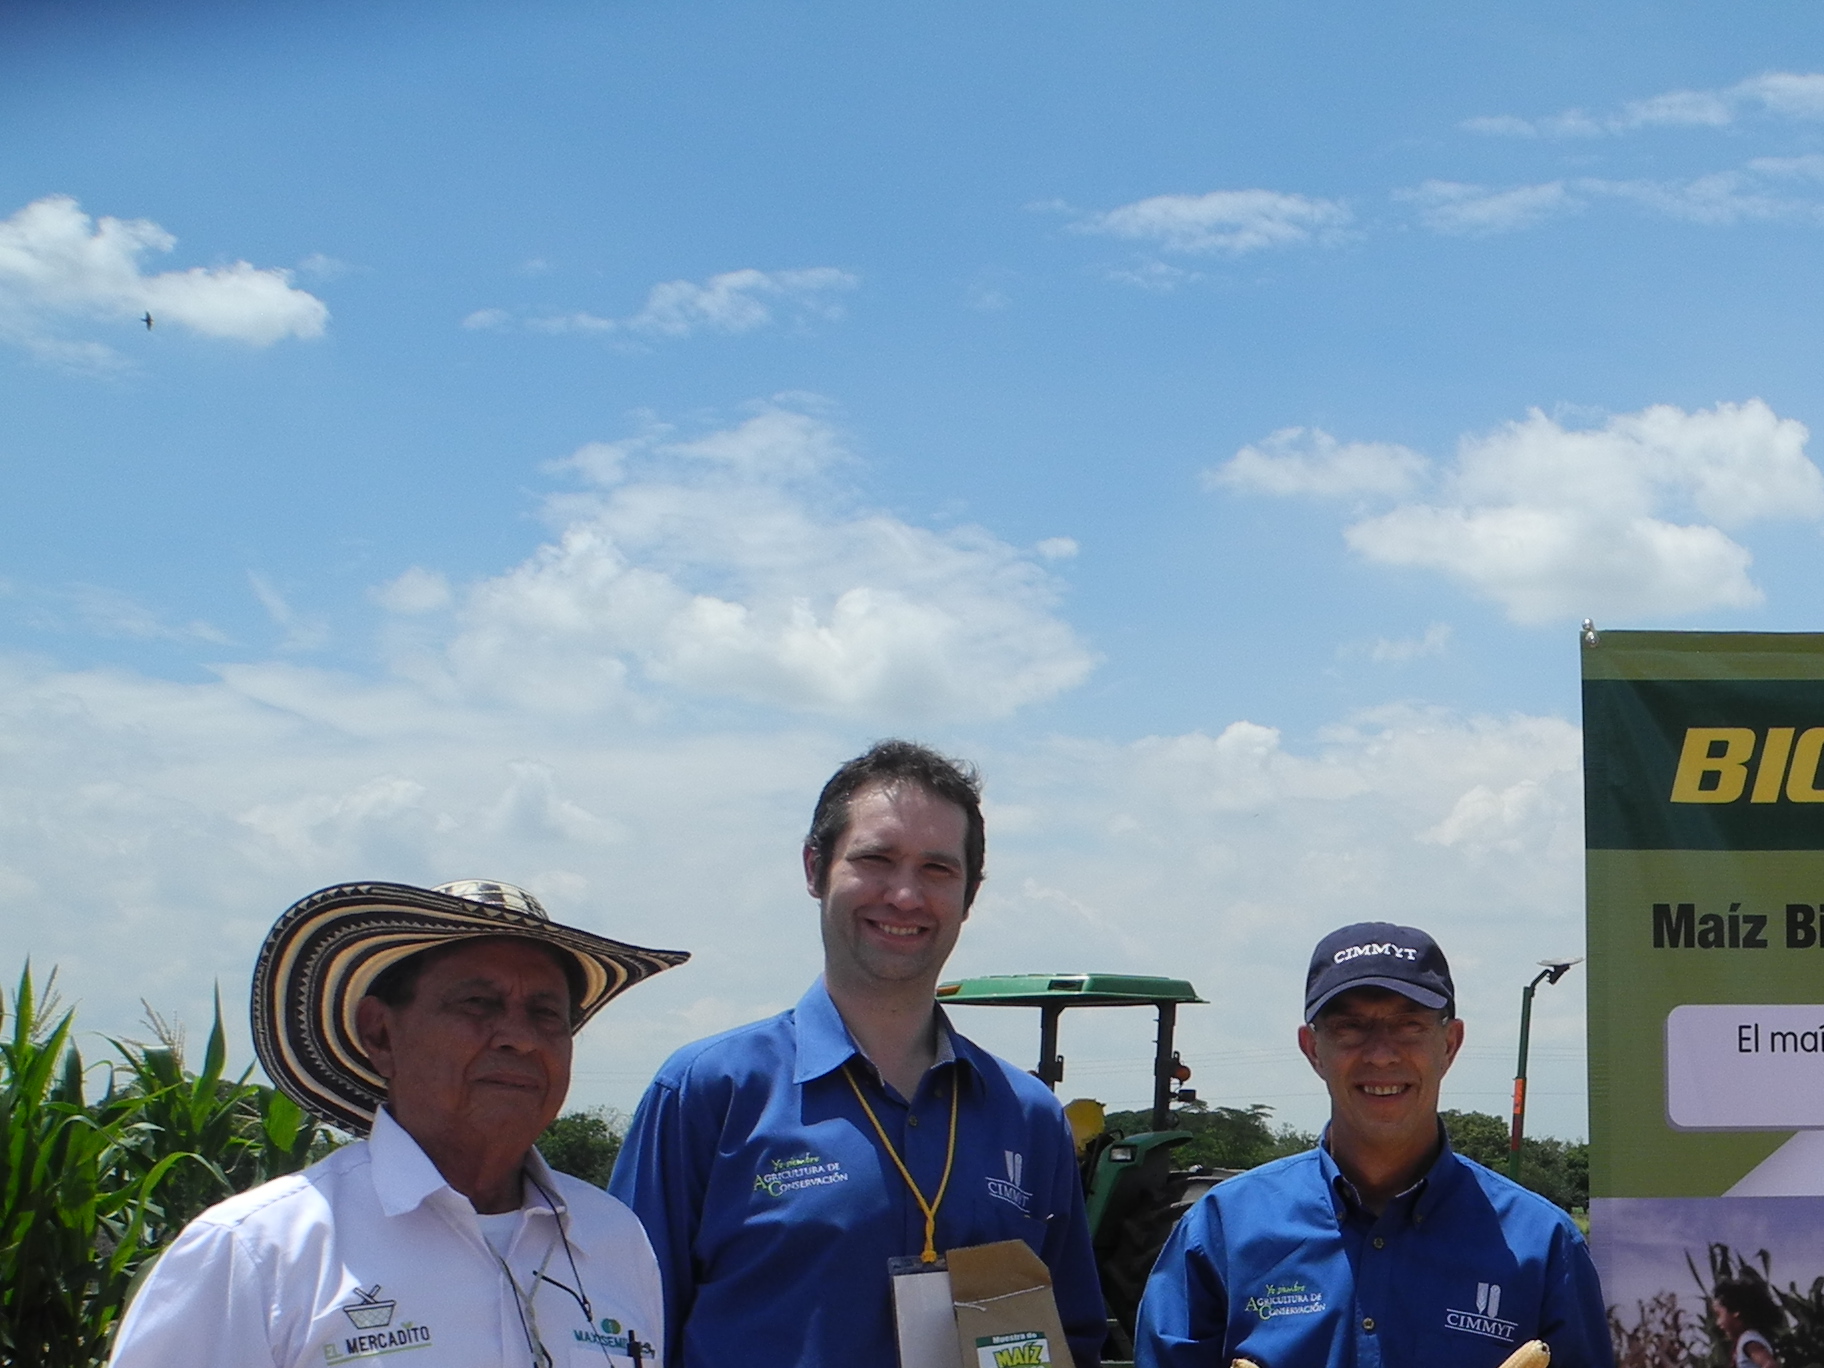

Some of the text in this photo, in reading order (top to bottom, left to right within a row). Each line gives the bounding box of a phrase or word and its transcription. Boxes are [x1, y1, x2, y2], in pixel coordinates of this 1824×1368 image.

[1652, 902, 1767, 949] Maíz
[1333, 943, 1419, 964] CIMMYT
[1737, 1024, 1760, 1053] El
[1446, 1313, 1515, 1337] CIMMYT
[325, 1326, 431, 1360] EL MERCADITO
[993, 1342, 1043, 1368] MAÍZ
